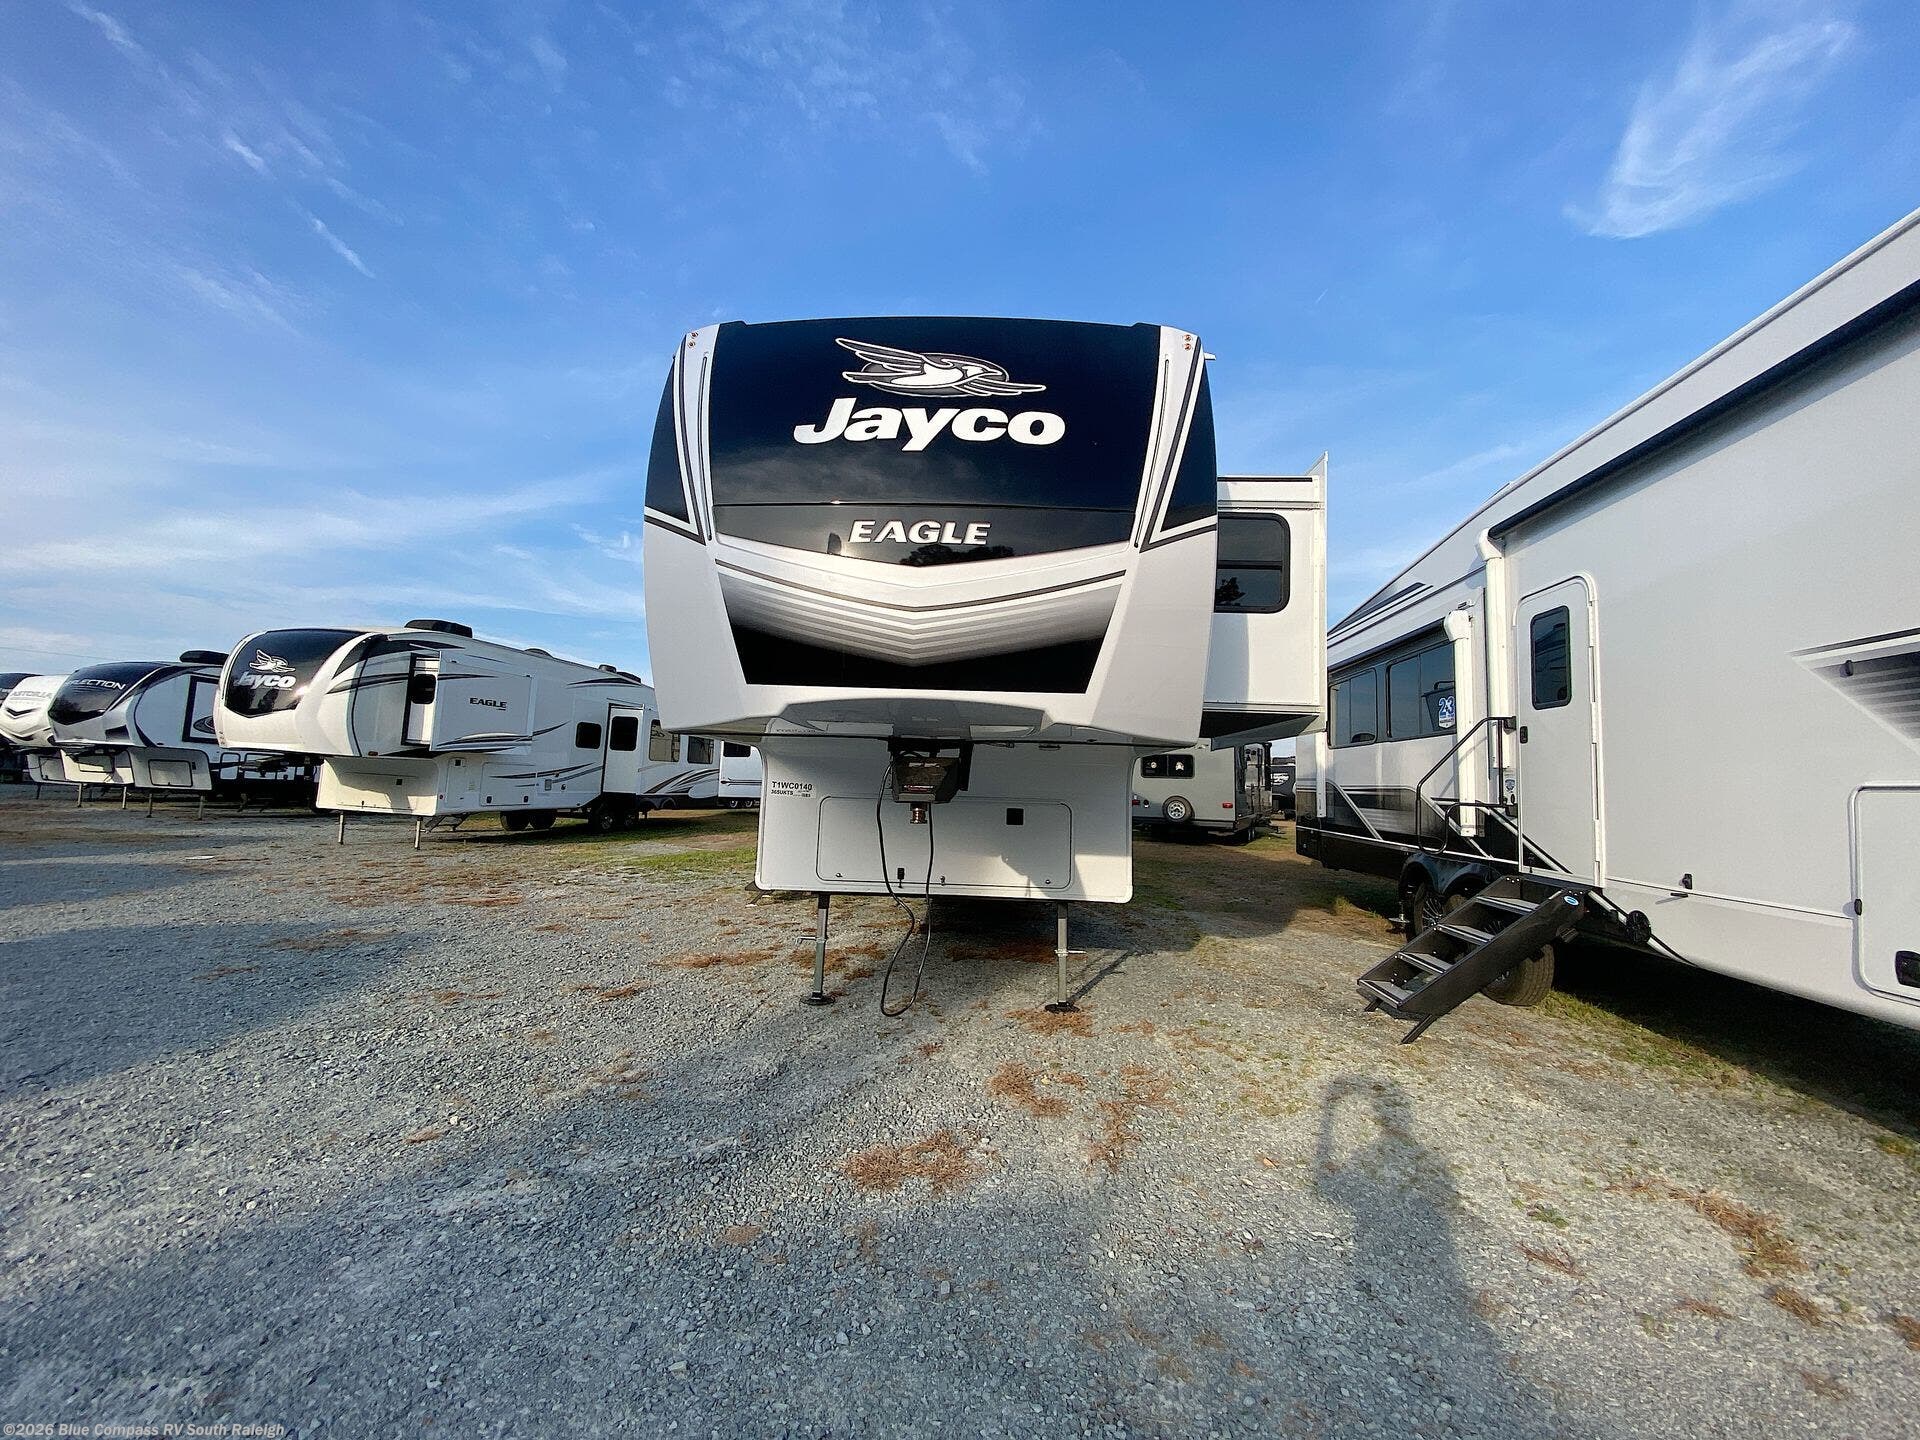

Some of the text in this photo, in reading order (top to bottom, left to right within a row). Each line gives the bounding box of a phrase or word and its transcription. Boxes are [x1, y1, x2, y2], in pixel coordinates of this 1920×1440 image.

[793, 397, 1066, 452] Jayco
[849, 519, 992, 546] EAGLE
[233, 671, 297, 690] Jayco
[469, 697, 508, 709] EAGLE
[771, 781, 813, 791] T1WC0140
